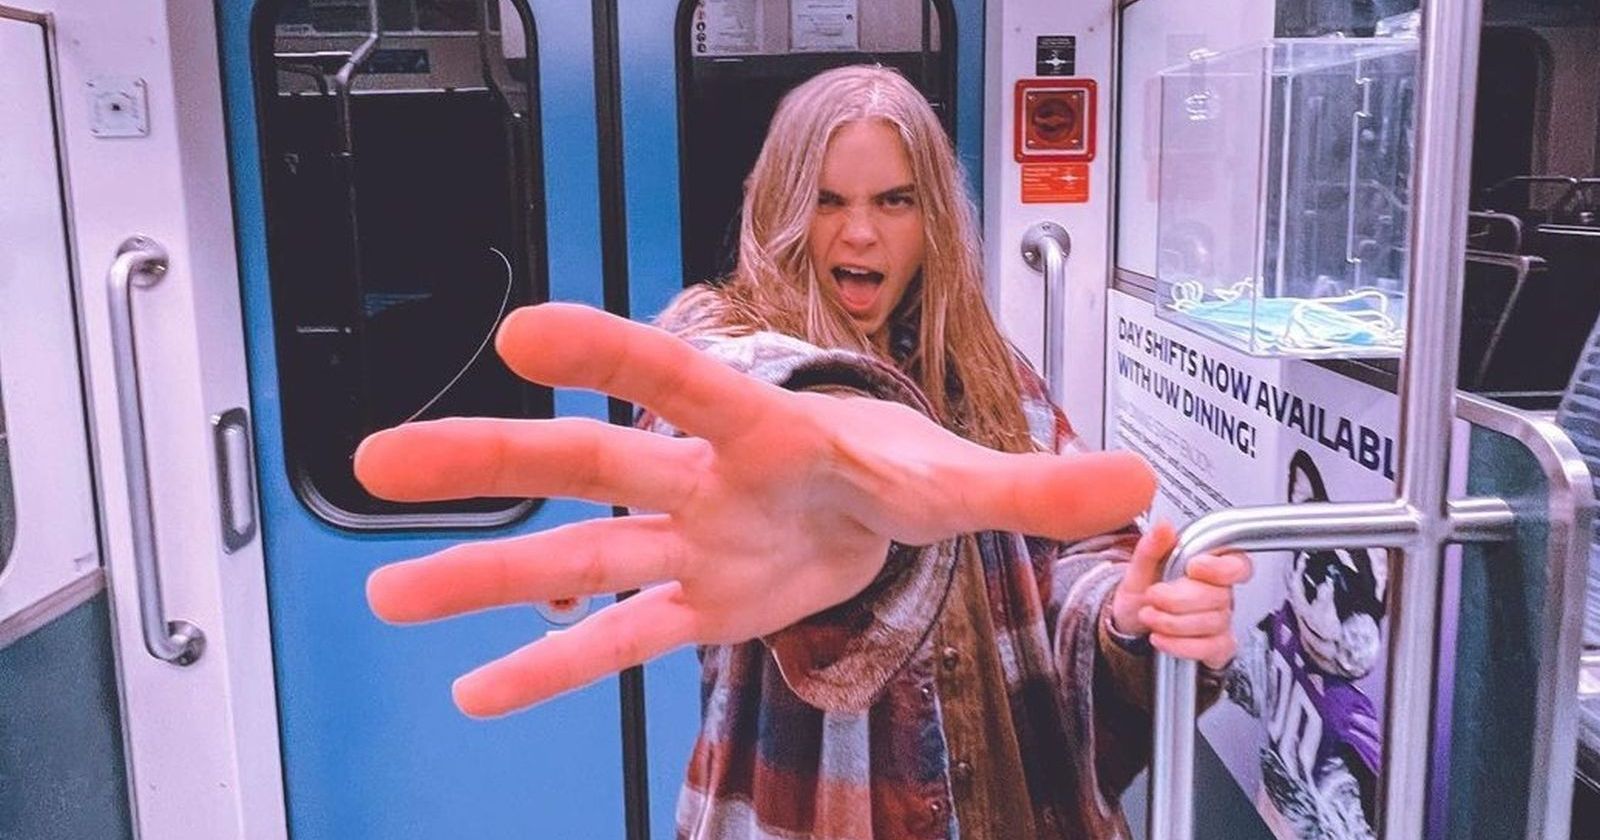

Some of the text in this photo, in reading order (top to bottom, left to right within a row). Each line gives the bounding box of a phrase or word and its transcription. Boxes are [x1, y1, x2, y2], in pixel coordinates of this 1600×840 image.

[1118, 316, 1143, 348] DAY
[1145, 330, 1198, 377] SHIFTS
[1201, 354, 1252, 404] NOW
[1118, 351, 1151, 393] WITH
[1154, 372, 1180, 409] UW
[1183, 388, 1256, 459] DINING!
